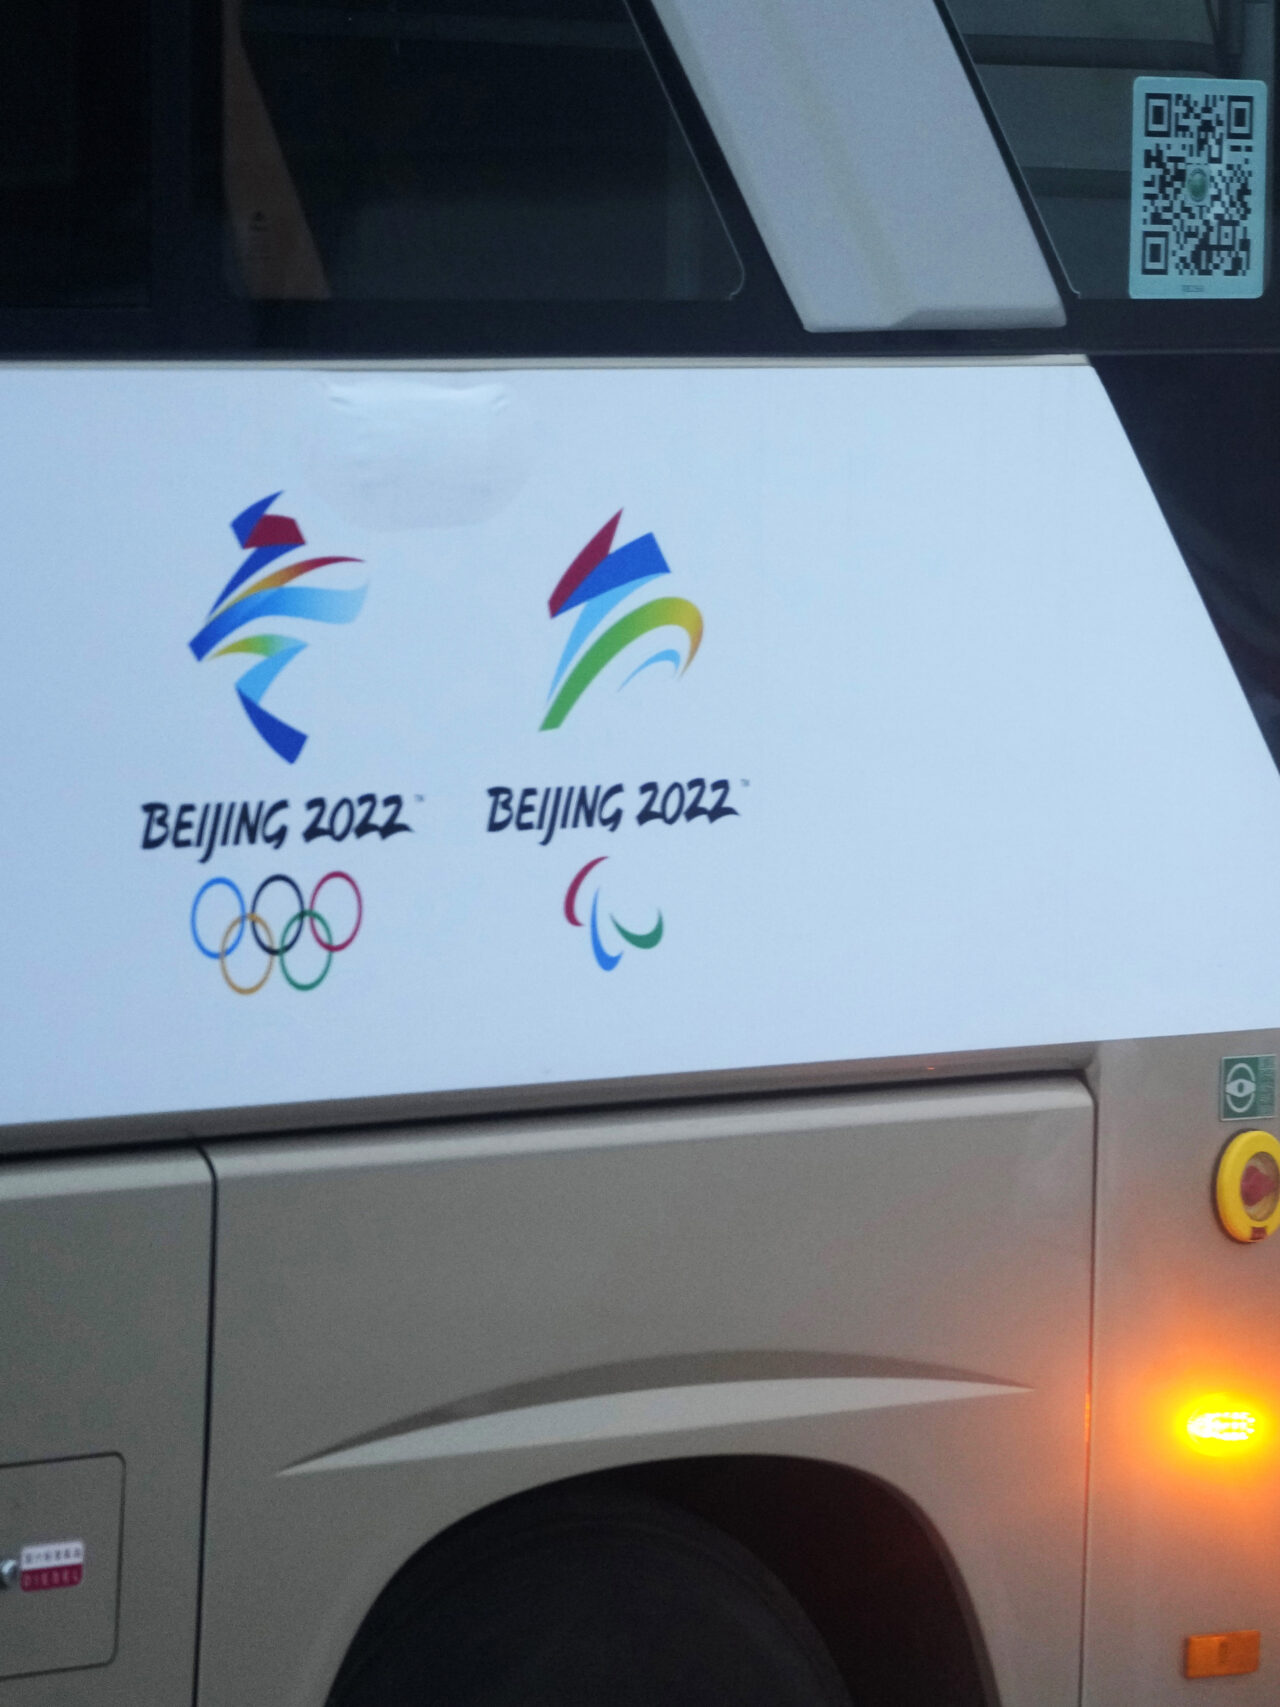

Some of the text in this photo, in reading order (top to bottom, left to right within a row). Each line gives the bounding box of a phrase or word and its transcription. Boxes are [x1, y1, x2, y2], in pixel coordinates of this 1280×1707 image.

[140, 792, 415, 865] BEIJING 2022
[486, 776, 741, 847] BEIJING 2022
